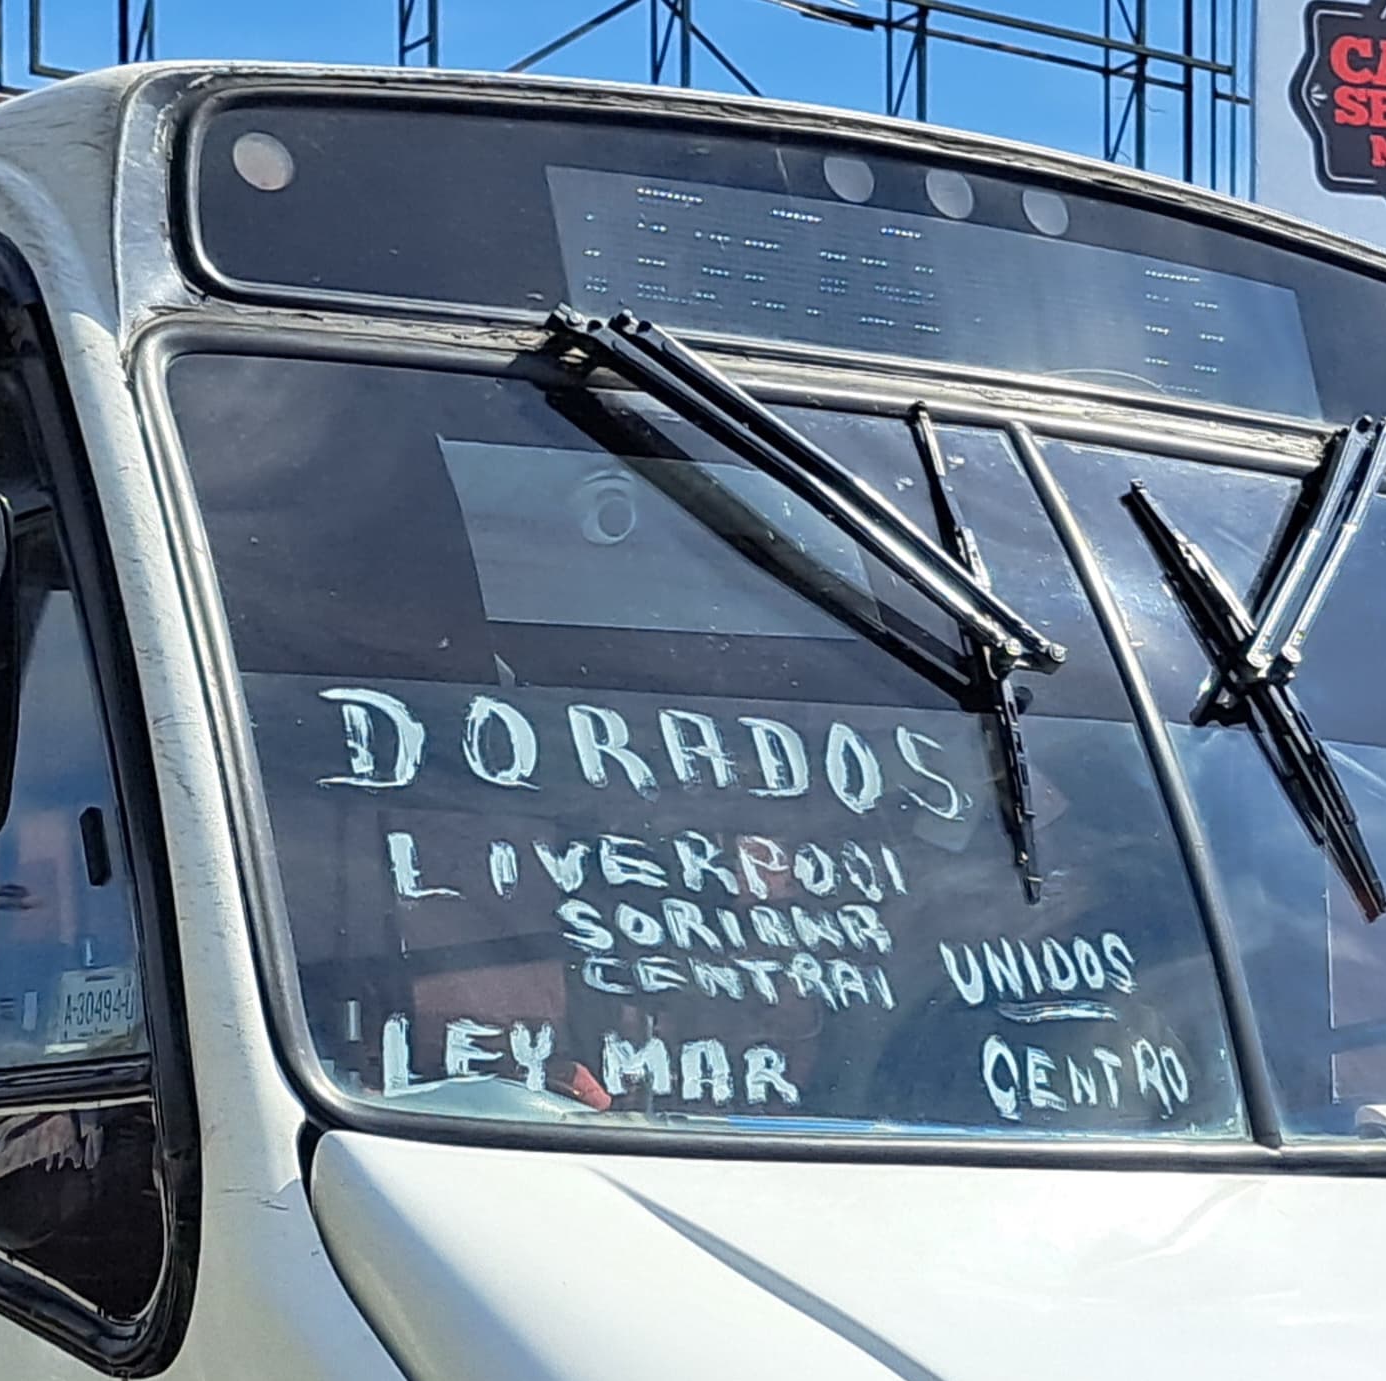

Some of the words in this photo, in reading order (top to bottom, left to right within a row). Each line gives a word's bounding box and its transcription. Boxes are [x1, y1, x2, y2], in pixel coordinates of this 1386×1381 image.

[315, 686, 973, 822] DORADOS
[938, 931, 1138, 1007] UNIDOS
[381, 1012, 556, 1098] LEY
[601, 1030, 800, 1106] MAR
